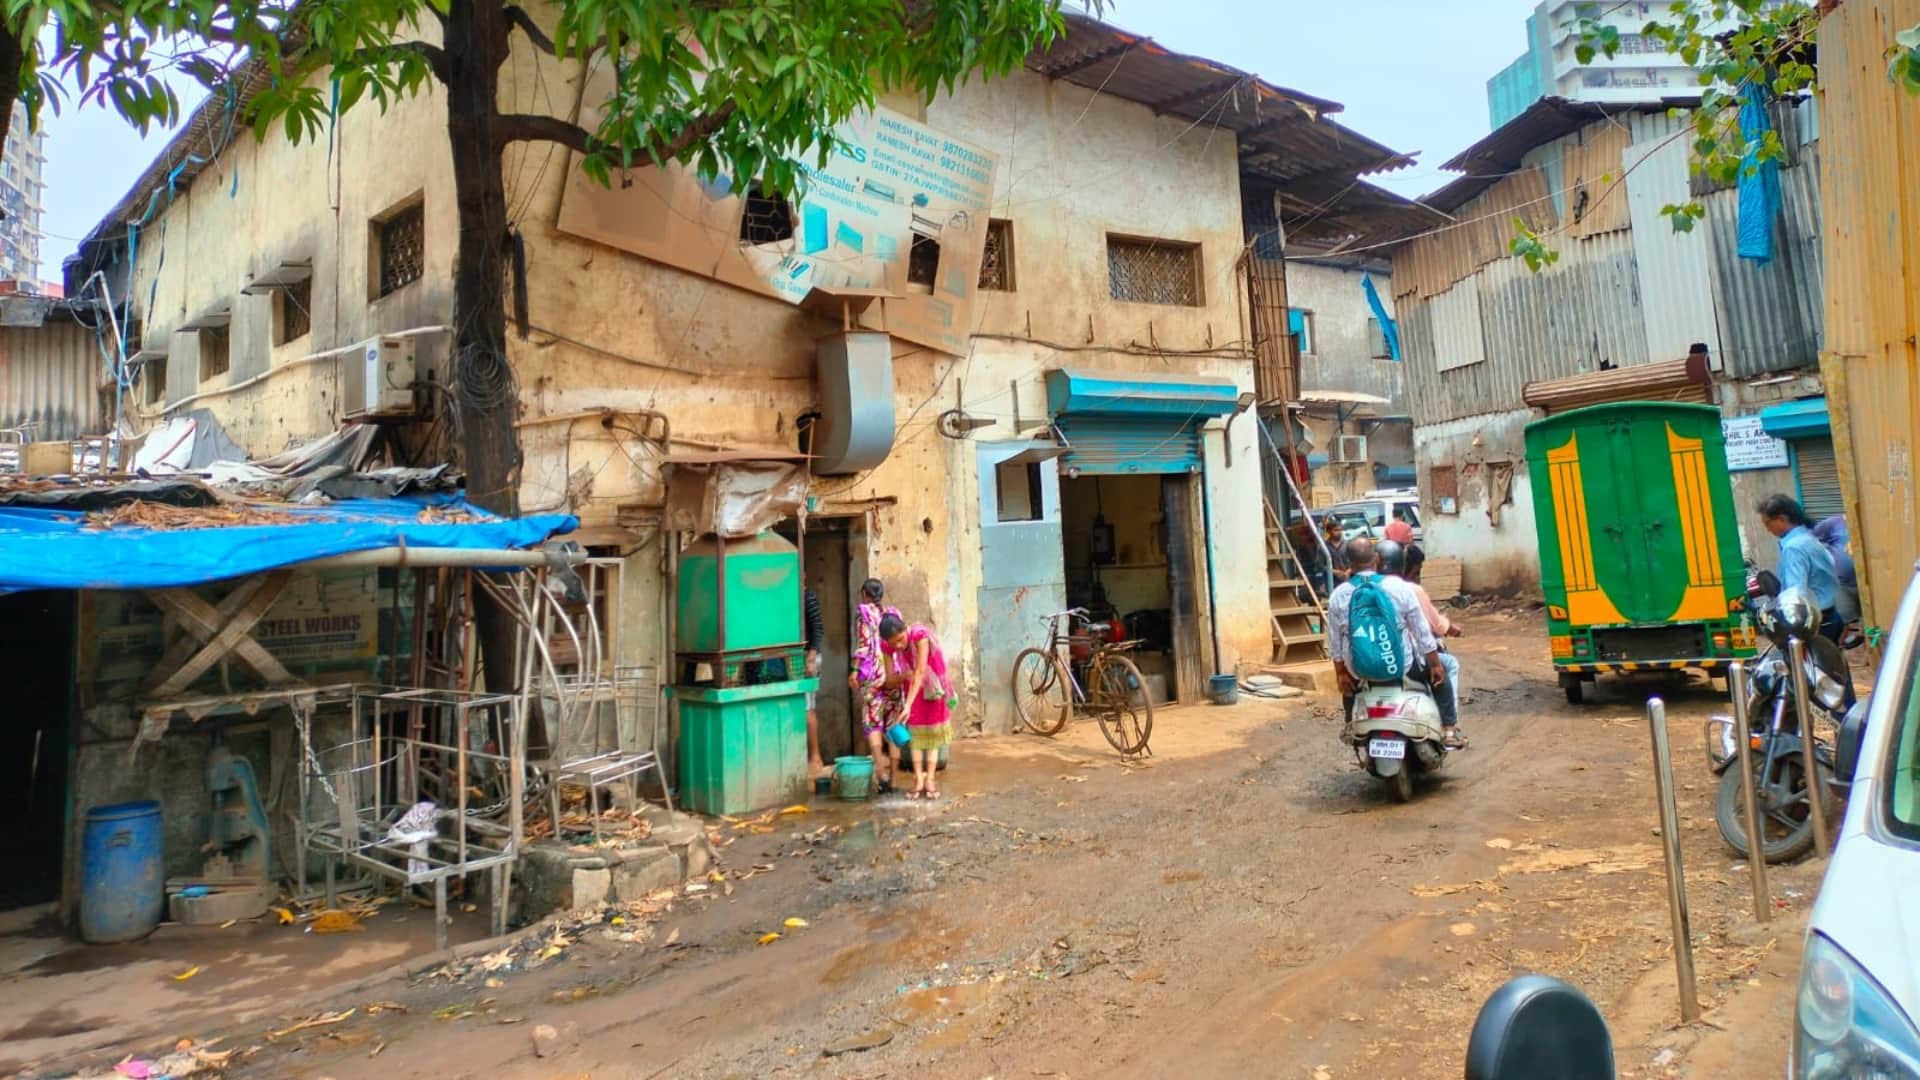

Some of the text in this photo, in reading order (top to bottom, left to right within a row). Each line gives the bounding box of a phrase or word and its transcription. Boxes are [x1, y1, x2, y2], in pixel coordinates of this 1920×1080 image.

[258, 615, 362, 637] STEEL WORKS
[1378, 623, 1399, 675] adidas
